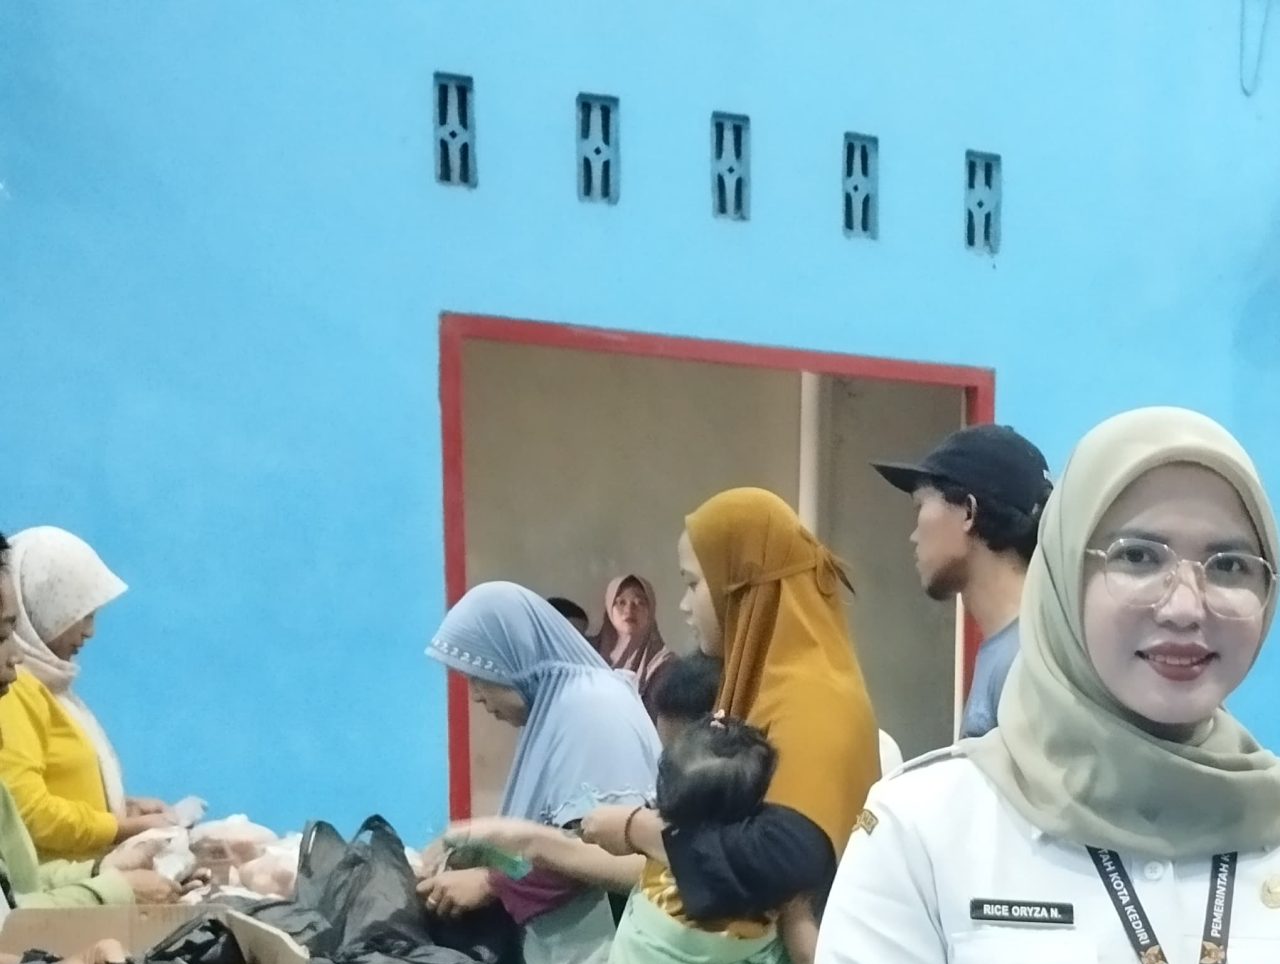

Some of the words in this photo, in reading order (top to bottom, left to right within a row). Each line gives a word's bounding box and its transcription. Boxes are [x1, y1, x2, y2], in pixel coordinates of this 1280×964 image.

[983, 904, 1010, 916] RICE
[1011, 906, 1049, 918] ORYZA
[1050, 908, 1062, 919] N.
[1108, 872, 1131, 906] KOTA
[1124, 905, 1150, 945] KEDIRI
[1211, 863, 1229, 938] PEMERINTAH
